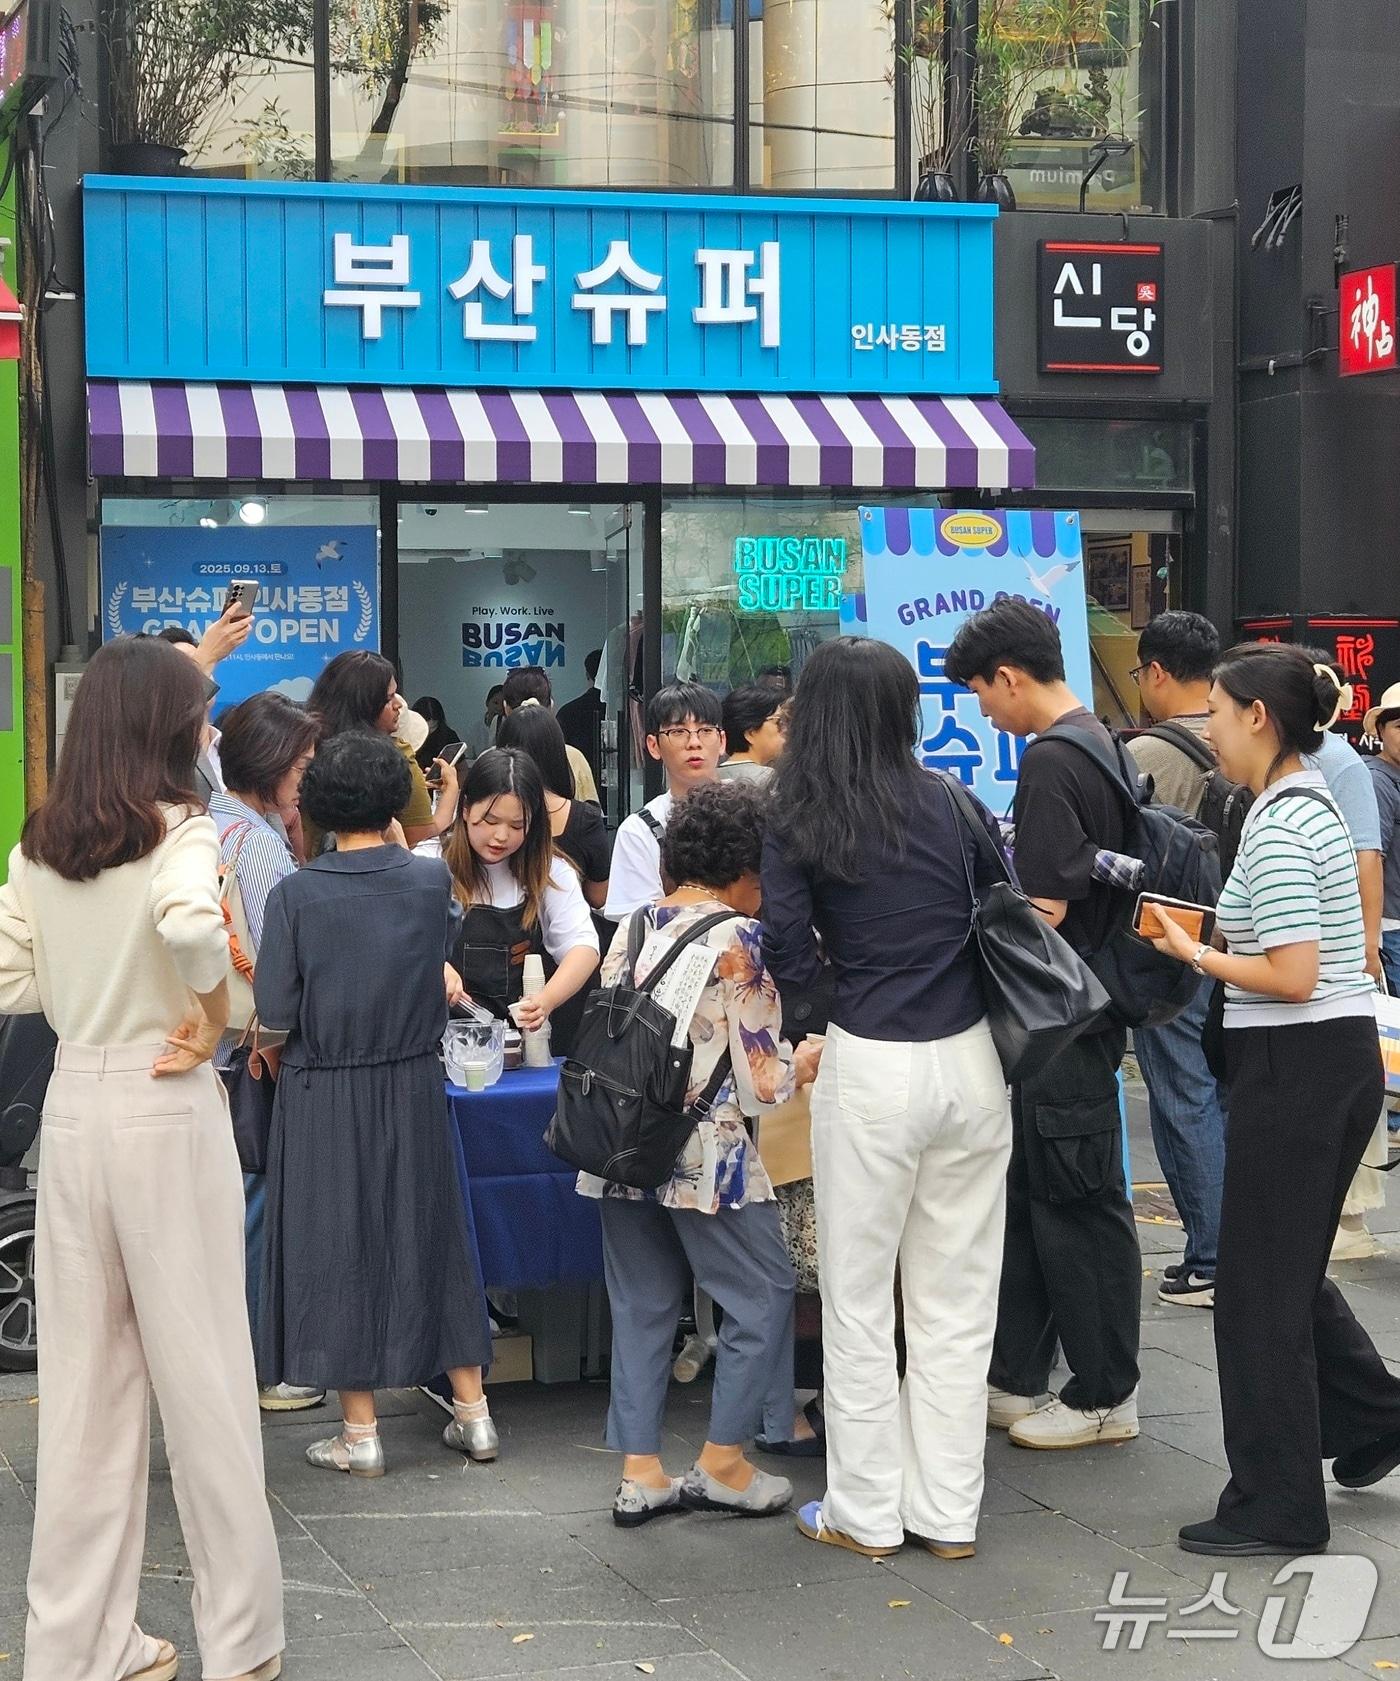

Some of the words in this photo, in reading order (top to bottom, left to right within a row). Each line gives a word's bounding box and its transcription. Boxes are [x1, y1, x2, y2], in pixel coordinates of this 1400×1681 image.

[323, 233, 780, 348] 부산슈퍼
[1053, 262, 1157, 357] 신당
[851, 323, 946, 352] 인사동점
[951, 526, 972, 534] BUSAN
[973, 526, 993, 535] SUPER
[200, 563, 282, 574] 2025.09.13.토
[736, 537, 846, 573] BUSAN
[738, 574, 842, 611] SUPER
[897, 589, 985, 627] GRAND
[472, 606, 498, 618] Play.
[500, 606, 531, 616] Work.
[534, 606, 554, 616] Live
[255, 618, 340, 644] OPEN
[462, 622, 565, 650] BUSAN
[917, 640, 977, 711] 부
